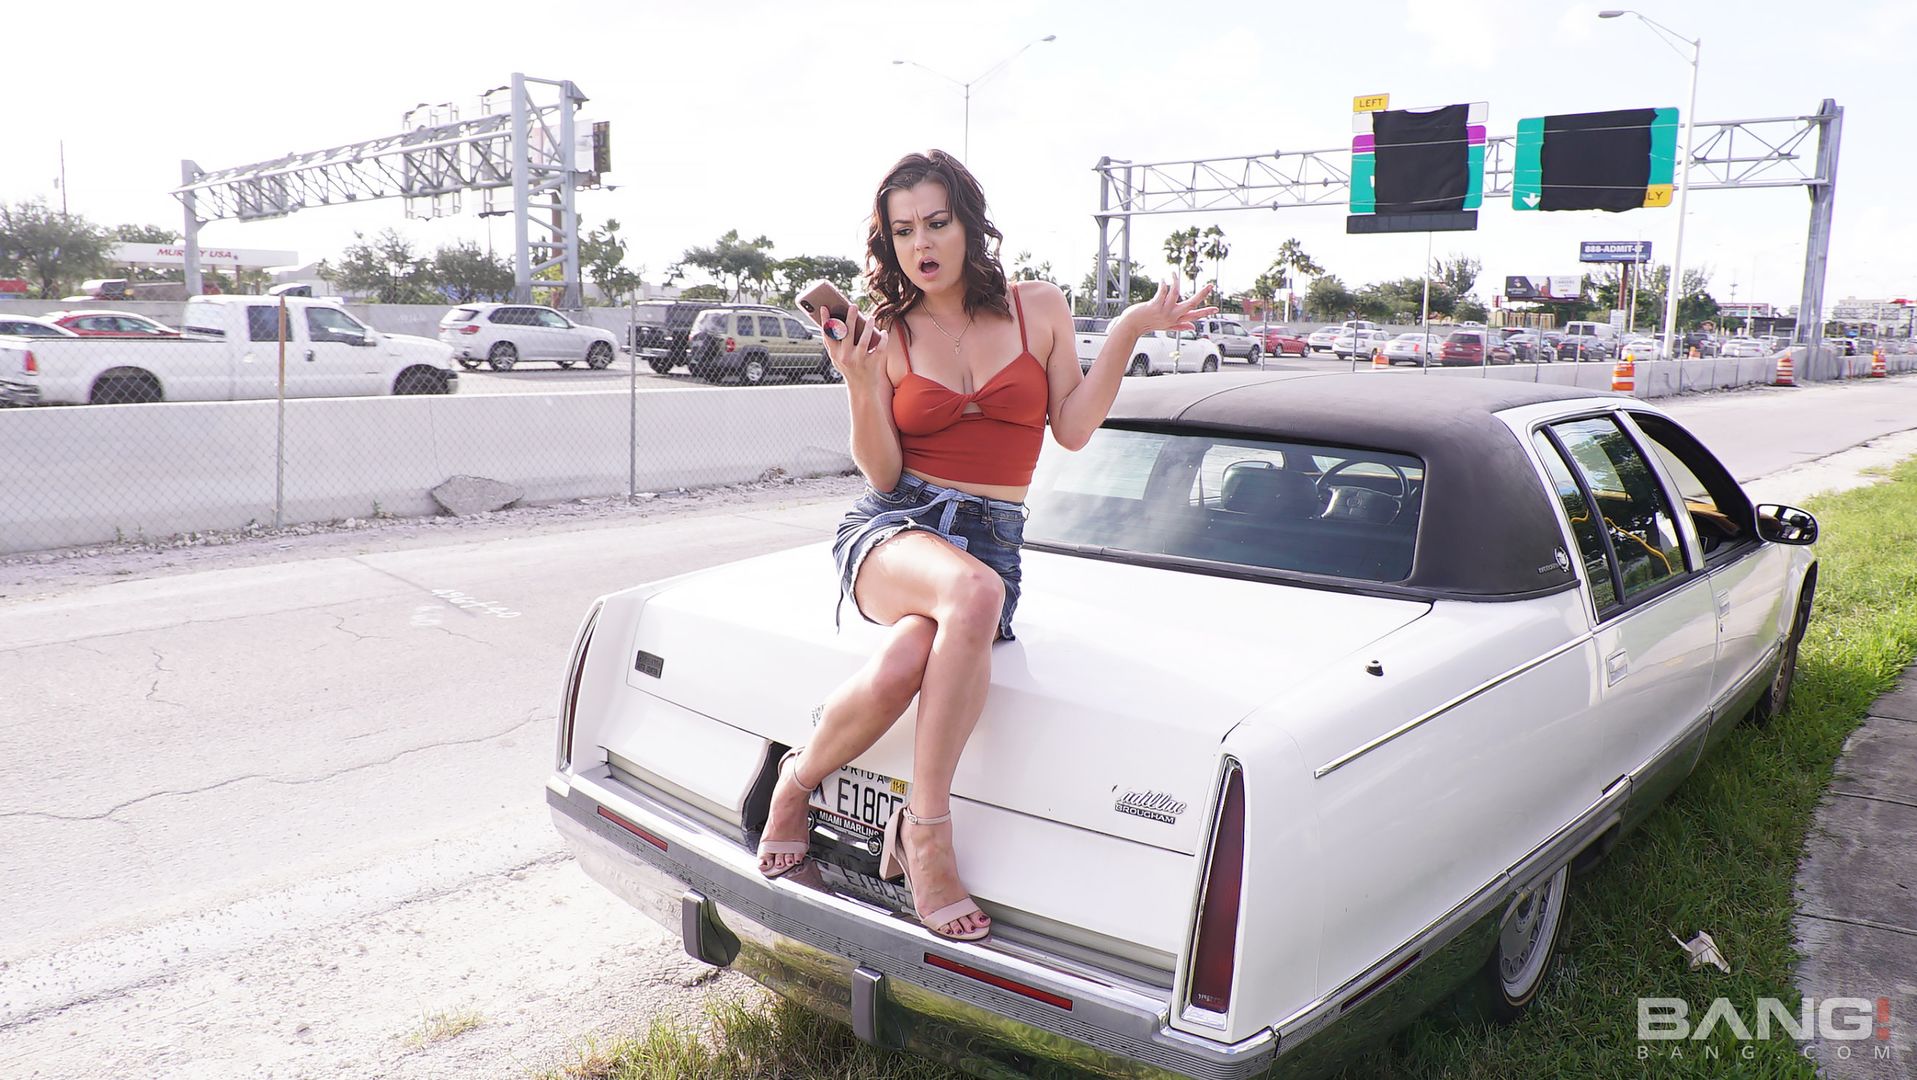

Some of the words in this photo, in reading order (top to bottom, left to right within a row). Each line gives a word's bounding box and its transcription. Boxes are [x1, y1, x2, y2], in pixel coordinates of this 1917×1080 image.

[1359, 98, 1383, 108] LEFT
[1647, 191, 1664, 201] LY
[157, 248, 207, 257] MURY
[209, 250, 232, 258] USA
[819, 810, 843, 824] MIAMI
[1115, 804, 1175, 824] BROUGHAM
